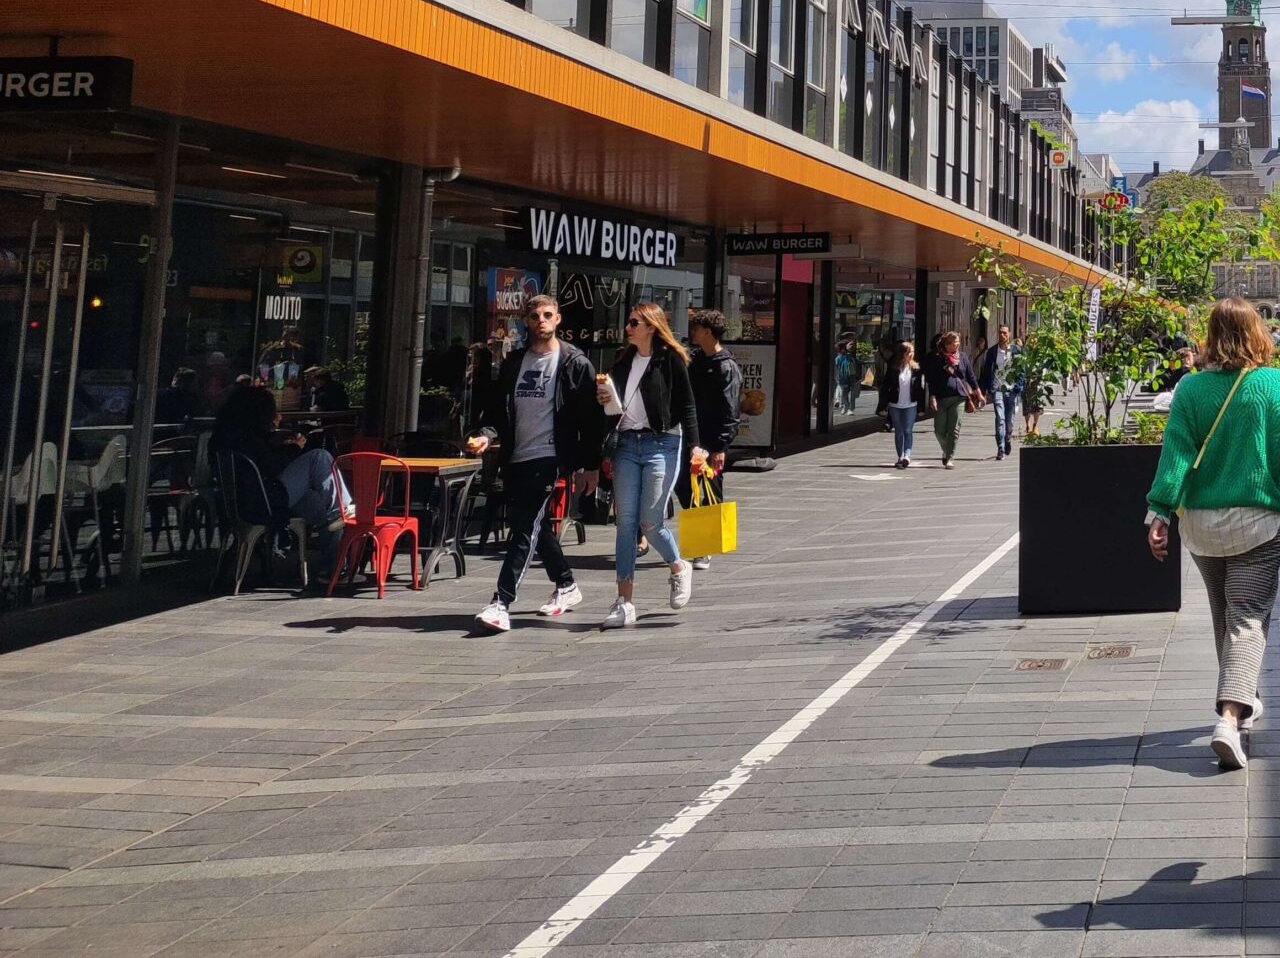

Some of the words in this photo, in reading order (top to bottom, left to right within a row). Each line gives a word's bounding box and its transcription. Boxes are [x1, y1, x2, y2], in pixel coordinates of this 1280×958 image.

[0, 72, 95, 97] RGER
[530, 207, 596, 256] WAW
[601, 220, 676, 266] BURGER
[733, 238, 768, 251] WAW
[773, 238, 823, 250] BURGER
[264, 295, 302, 320] MOJITO
